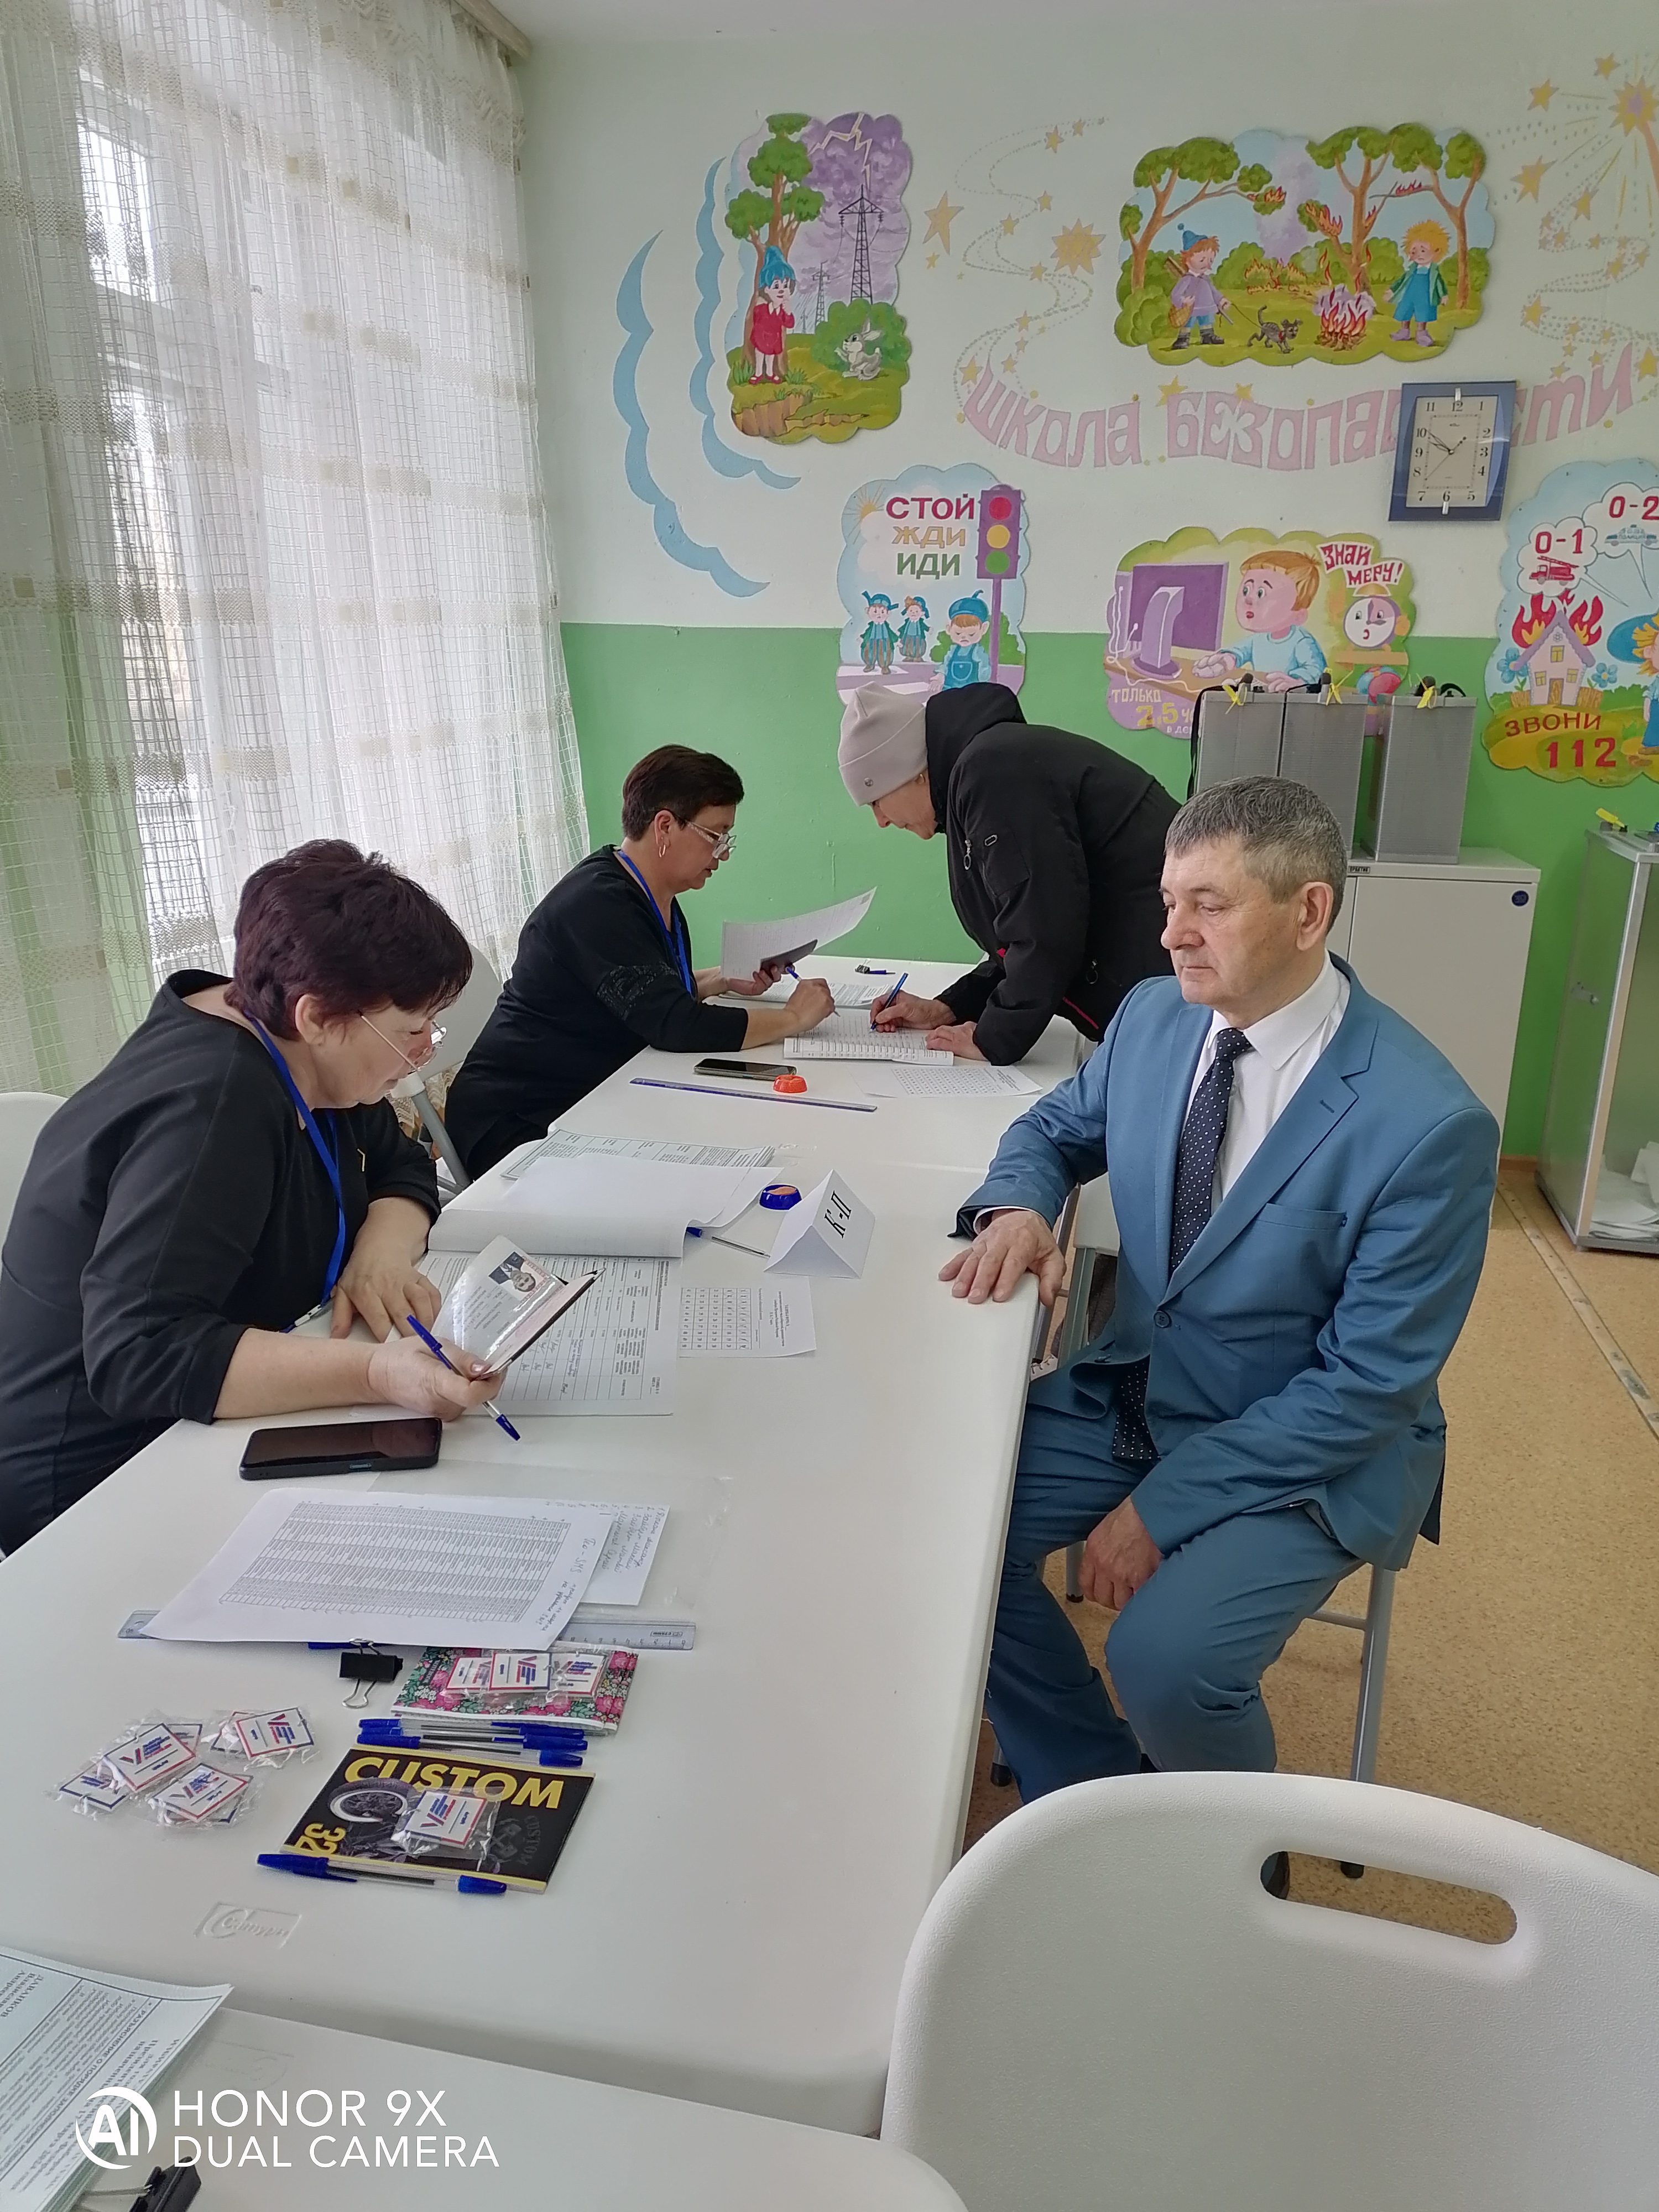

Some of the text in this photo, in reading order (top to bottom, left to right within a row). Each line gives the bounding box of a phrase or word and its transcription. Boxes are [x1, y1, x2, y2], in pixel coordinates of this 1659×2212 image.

[1426, 402, 1436, 411] 11
[1452, 401, 1463, 411] 12
[1479, 401, 1483, 410] 1
[1416, 427, 1427, 437] 10
[1483, 428, 1490, 438] 2
[1415, 447, 1423, 457] 9
[1480, 447, 1488, 457] 3
[1412, 467, 1421, 477] 8
[1478, 466, 1485, 476] 4
[1418, 491, 1425, 501] 7
[1442, 491, 1450, 502] 6
[1467, 491, 1475, 501] 5
[886, 493, 975, 520] СТОЙ
[891, 526, 966, 549] ЖДИ
[897, 552, 961, 580] ИДИ
[1347, 562, 1402, 585] МЕРУ!
[1112, 688, 1161, 703] ТОЛЬКО
[1504, 712, 1601, 737] ЗВОНИ
[1547, 737, 1616, 768] 112
[825, 1190, 852, 1239] К-П
[345, 1756, 565, 1809] CUSTOM
[294, 1823, 346, 1857] 32
